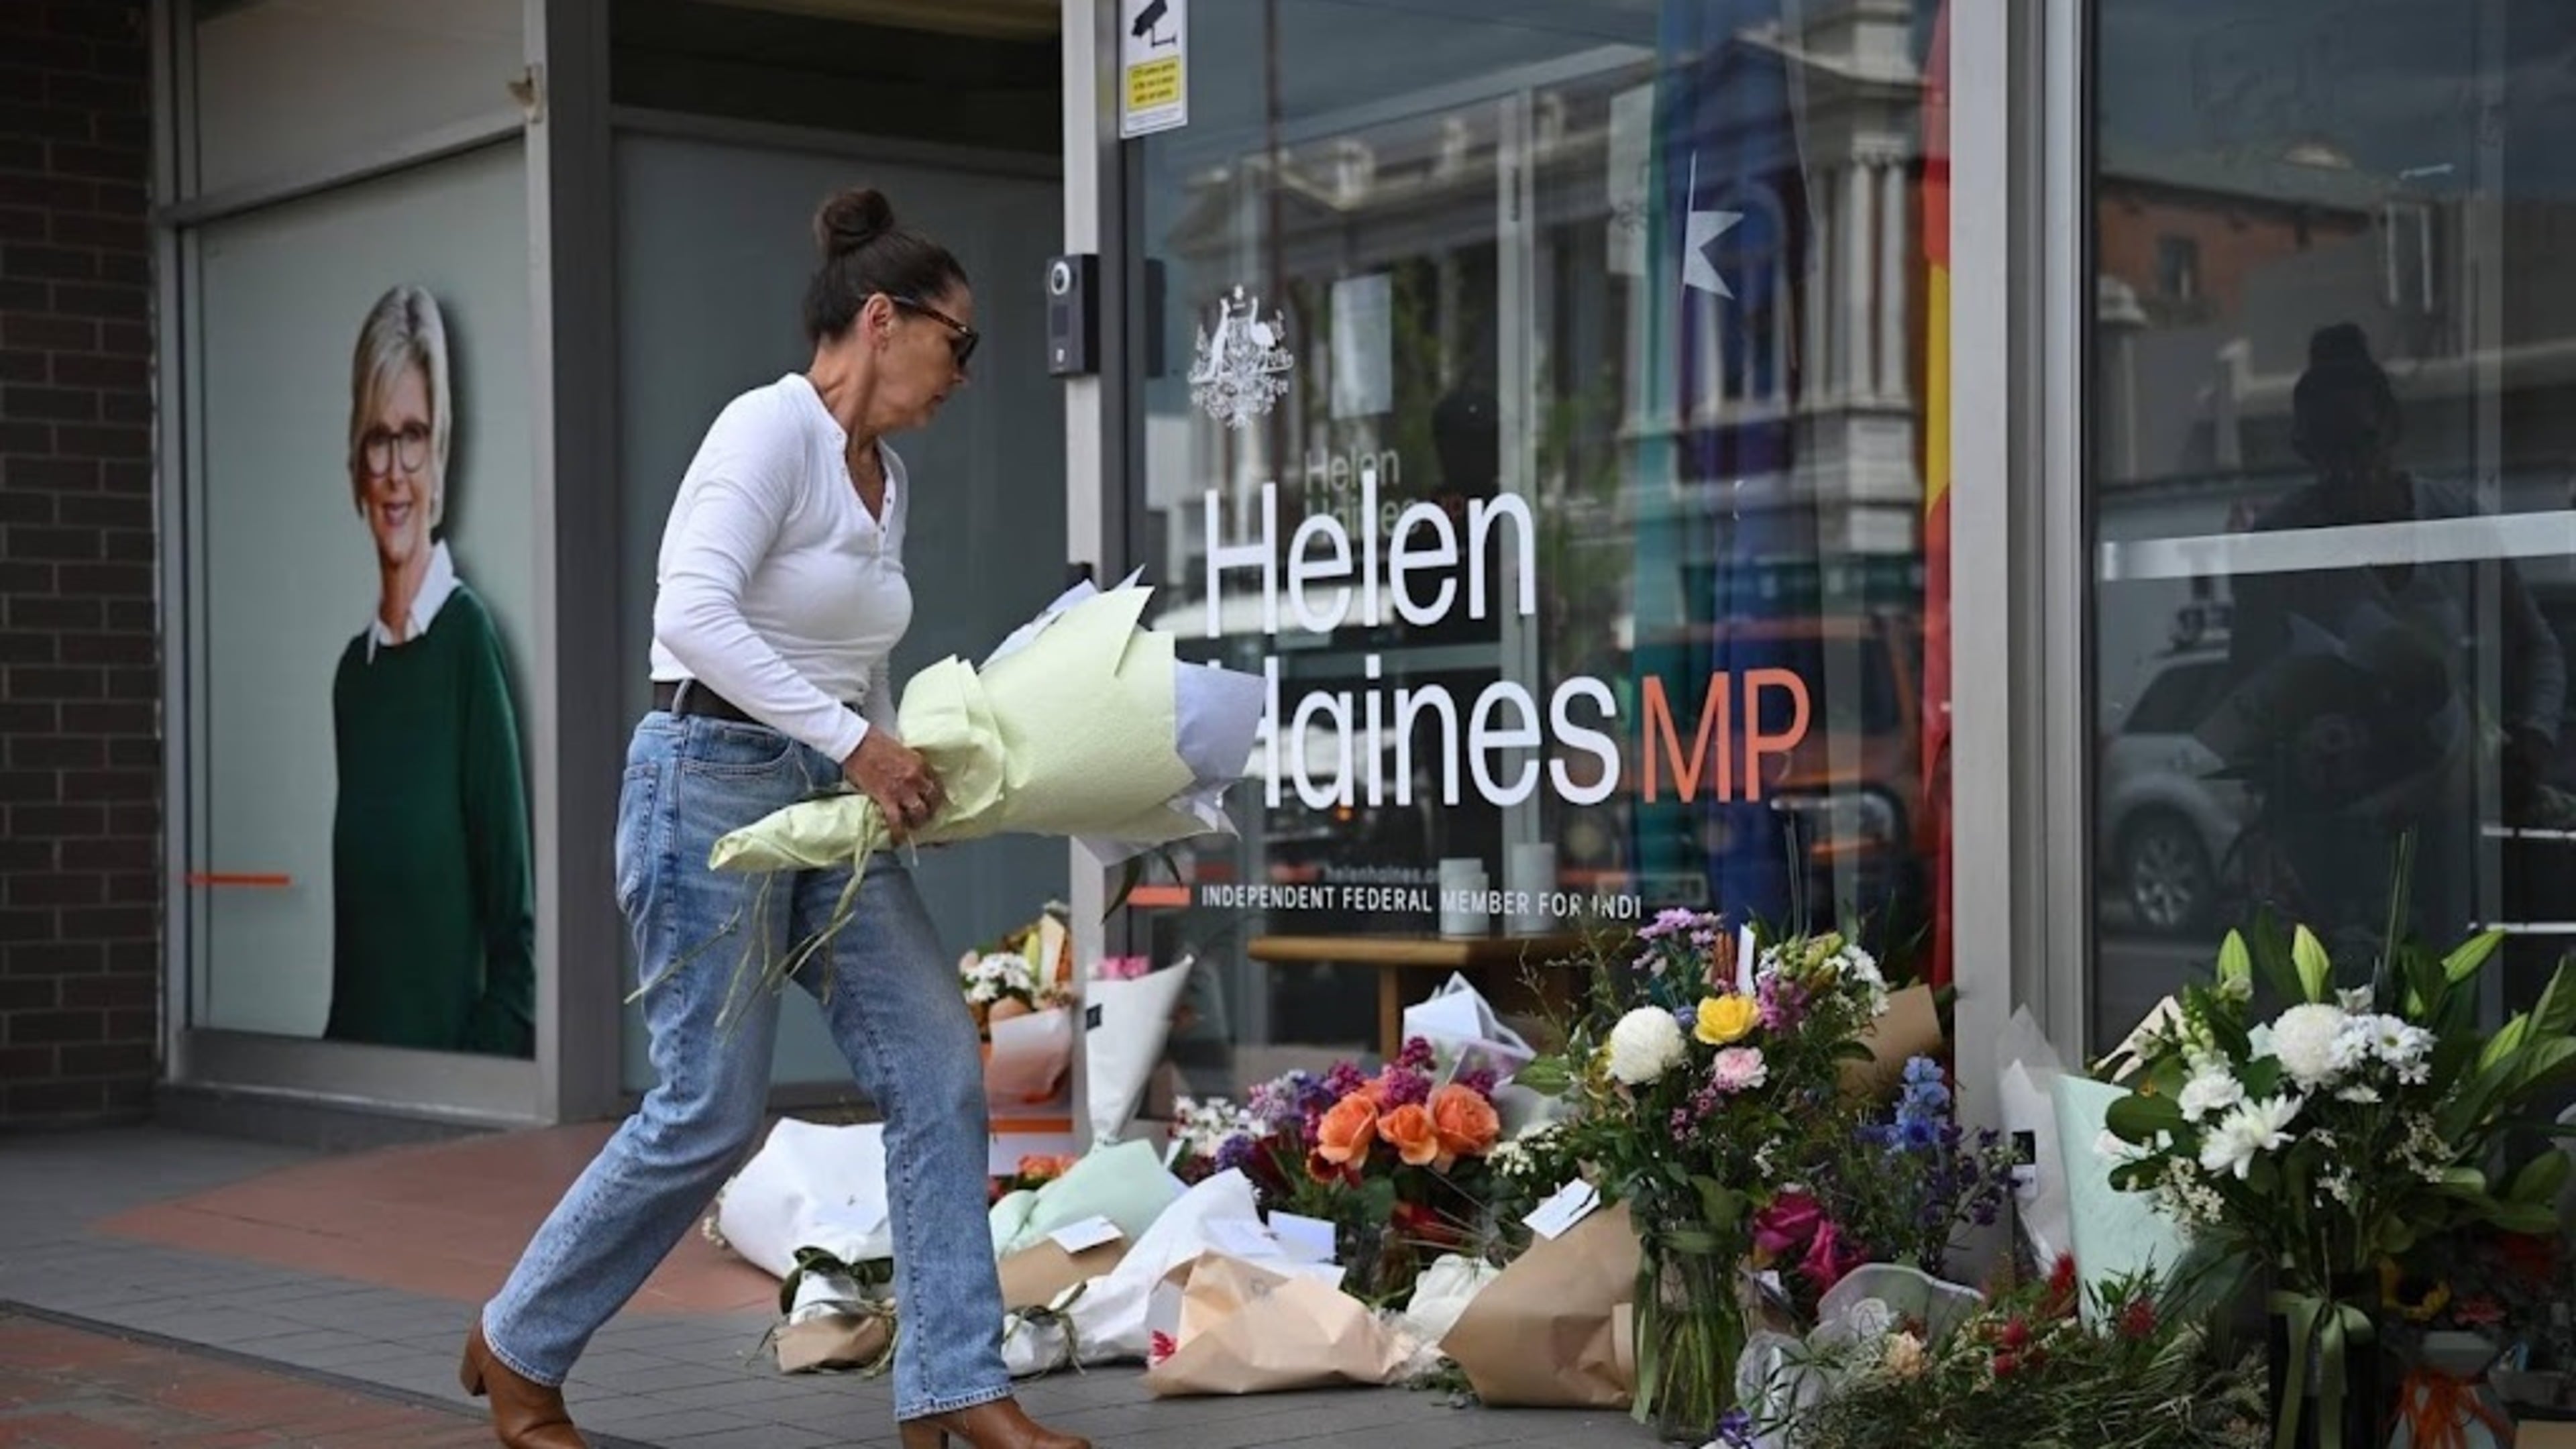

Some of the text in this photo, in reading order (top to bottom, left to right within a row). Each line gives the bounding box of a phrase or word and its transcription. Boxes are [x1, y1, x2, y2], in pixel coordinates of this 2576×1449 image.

[1205, 469, 1536, 638] Helen
[1642, 668, 1811, 804] MP
[1201, 884, 1642, 920] INDEPENDENT FEDERAL MEMBER FOR INDI
